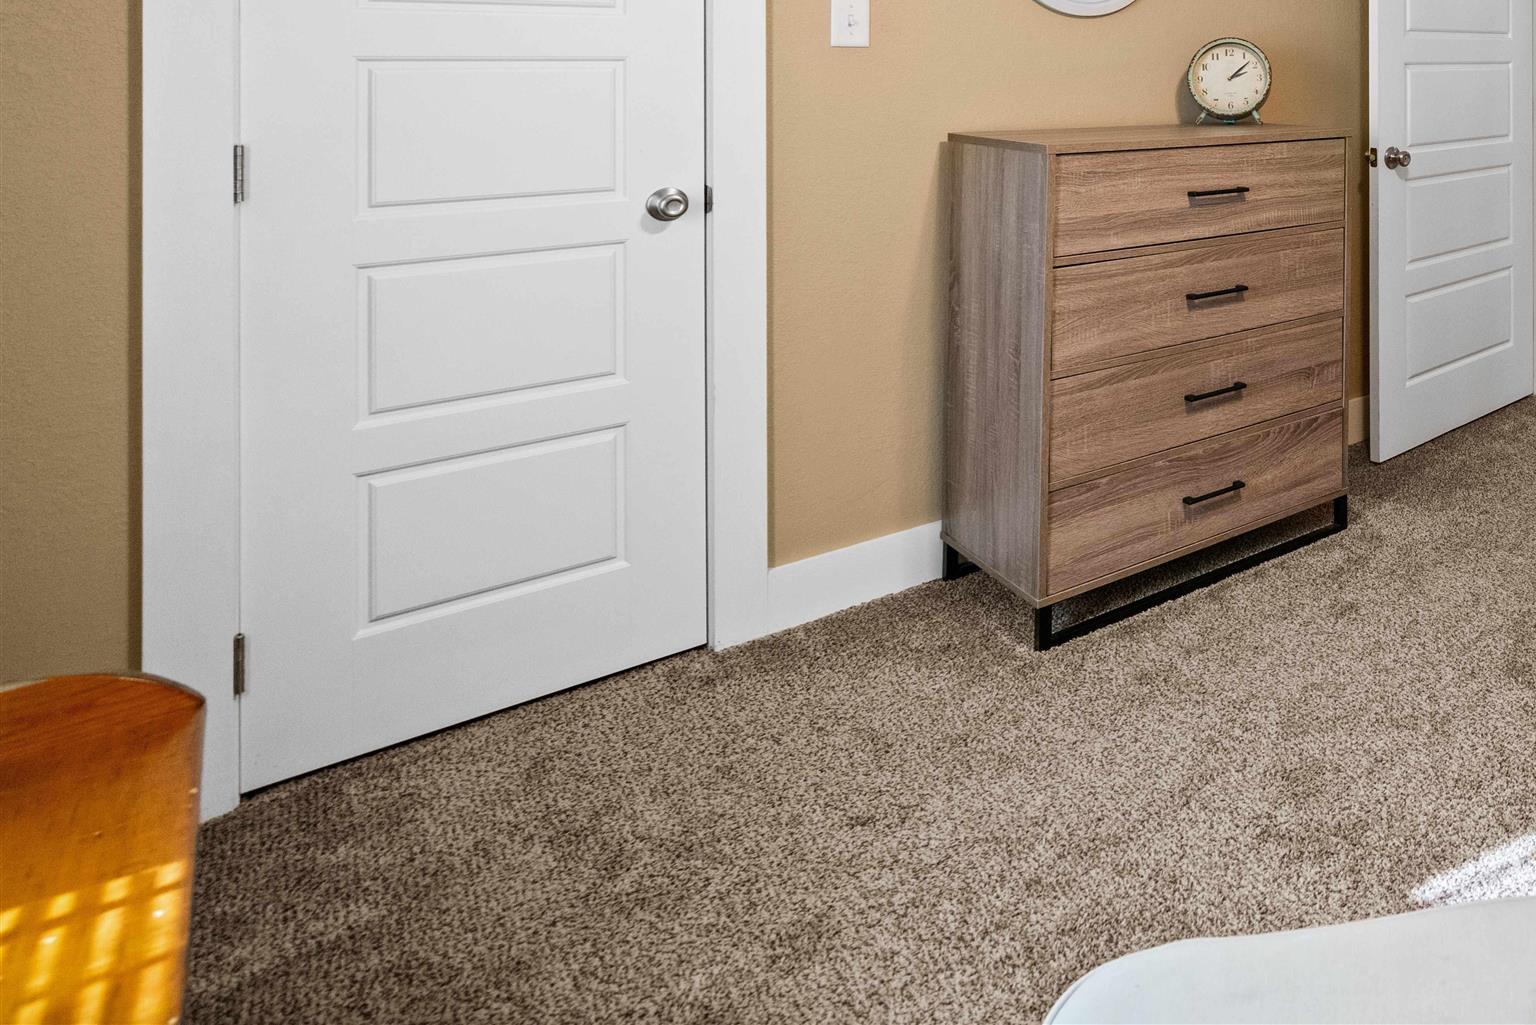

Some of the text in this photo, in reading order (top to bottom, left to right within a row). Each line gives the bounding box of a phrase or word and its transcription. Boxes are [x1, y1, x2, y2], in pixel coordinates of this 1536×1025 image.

[1211, 53, 1219, 61] 11
[1225, 48, 1235, 57] 12
[1227, 101, 1235, 110] 6
